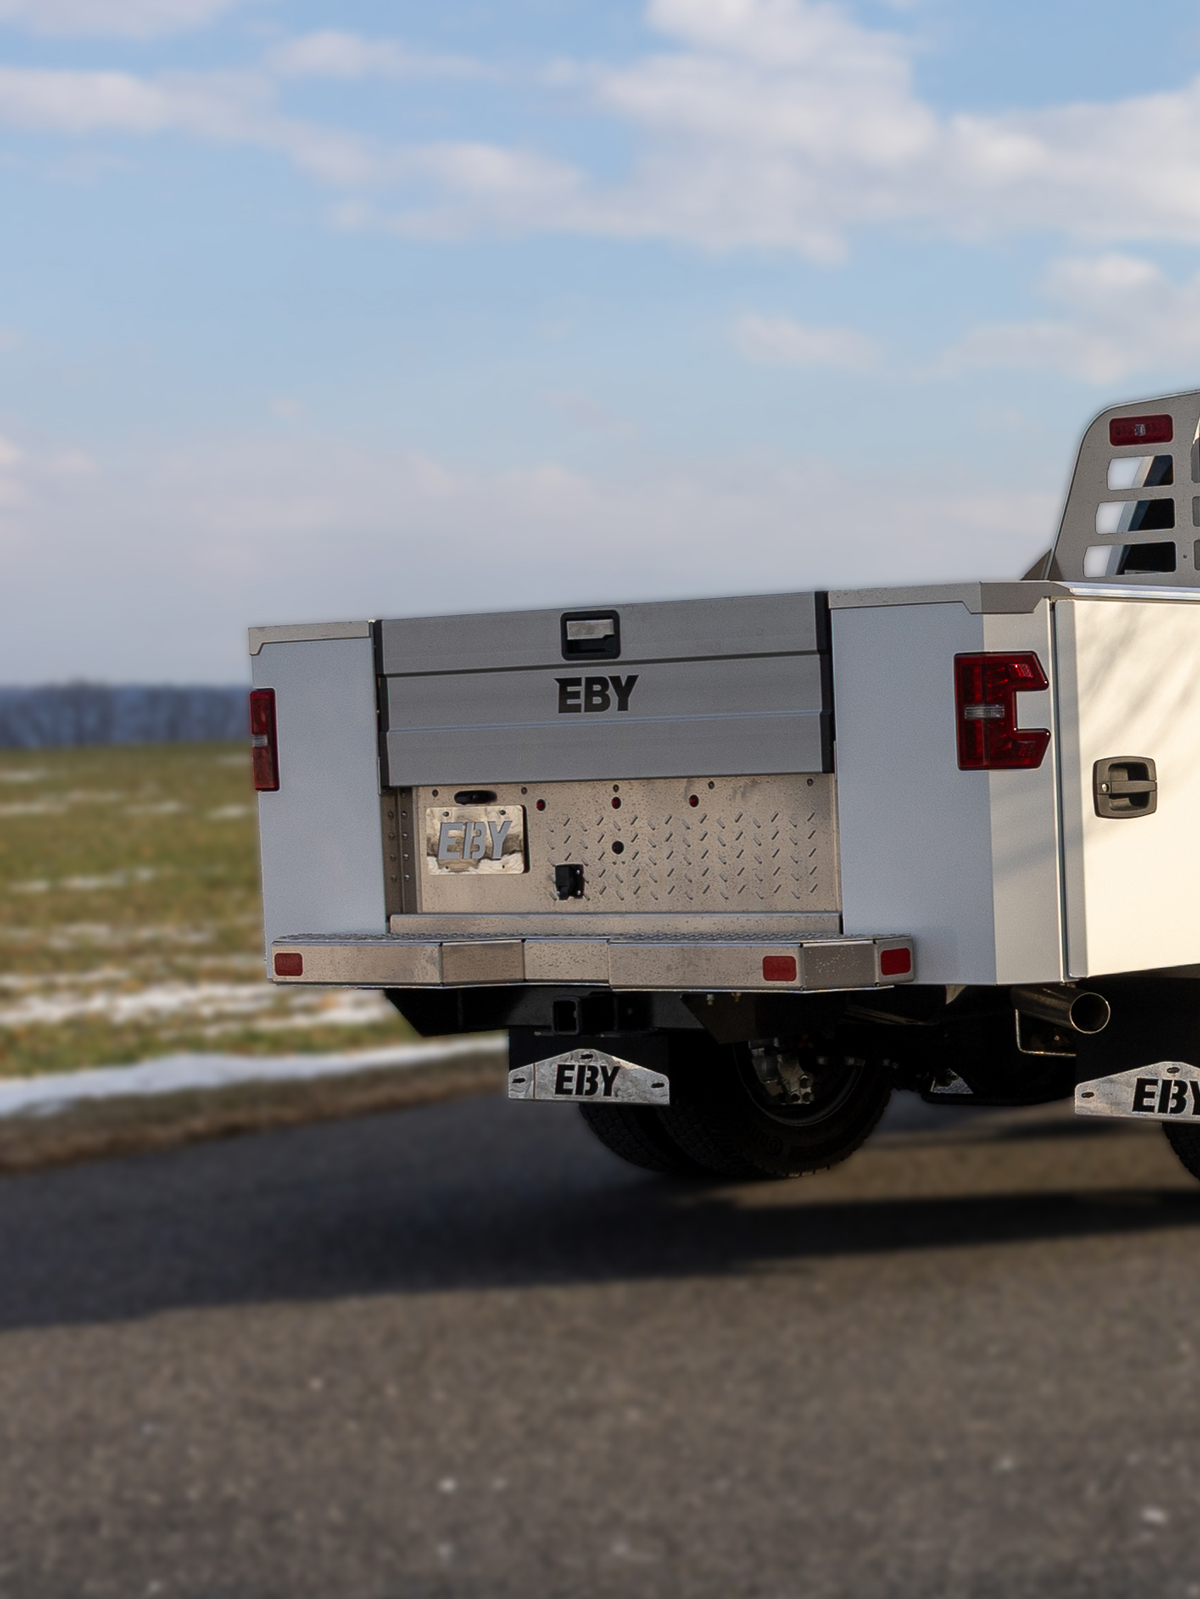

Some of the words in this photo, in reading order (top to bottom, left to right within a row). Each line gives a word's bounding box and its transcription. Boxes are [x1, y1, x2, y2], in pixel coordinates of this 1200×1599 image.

[554, 675, 639, 713] EBY
[438, 821, 513, 859] EBY
[555, 1064, 620, 1097] EBY
